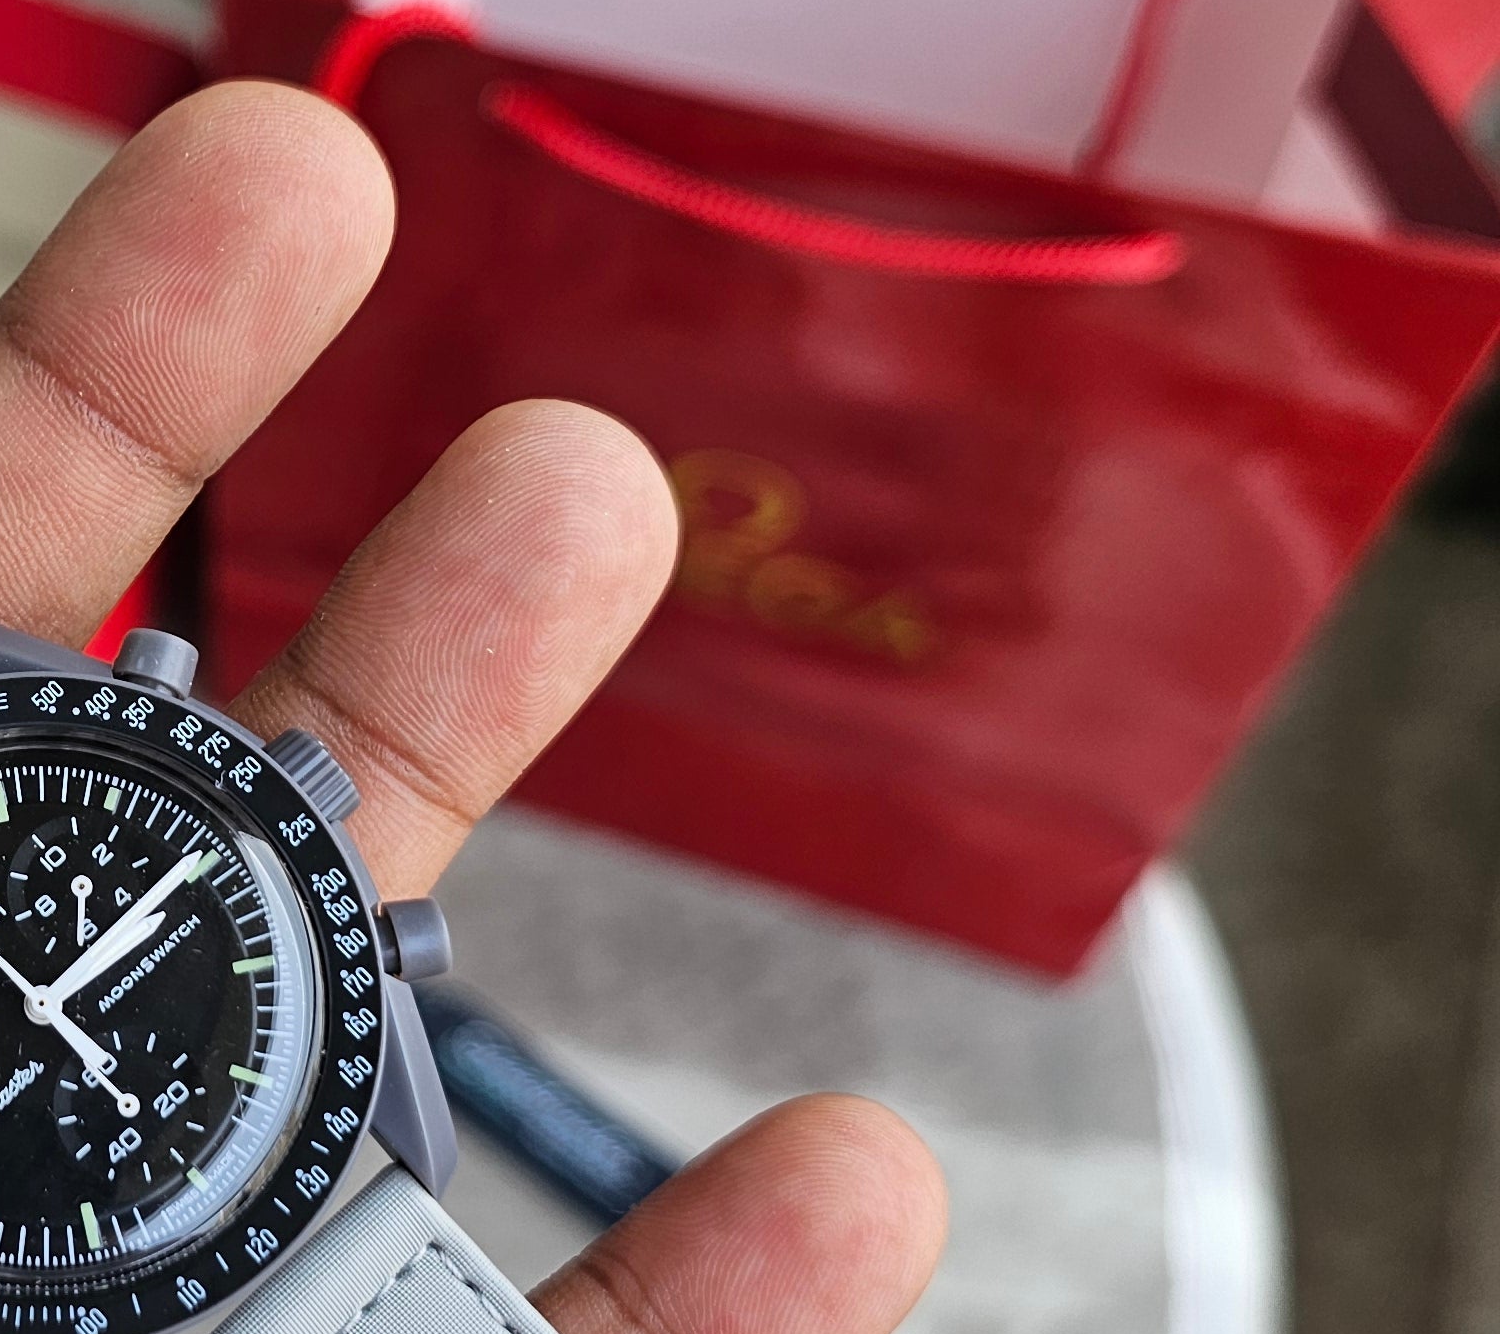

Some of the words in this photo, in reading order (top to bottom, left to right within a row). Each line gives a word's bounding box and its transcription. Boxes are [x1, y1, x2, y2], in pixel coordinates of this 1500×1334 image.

[31, 680, 64, 712] 500
[84, 686, 117, 716] 400
[121, 696, 155, 728] 350
[169, 714, 203, 746] 300
[198, 731, 231, 764] 275
[228, 756, 262, 788] 250
[282, 813, 316, 847] 225
[39, 845, 67, 873] 10
[91, 842, 115, 867] 2
[114, 886, 132, 907] 4
[312, 868, 347, 901] 200
[34, 894, 57, 917] 8
[325, 895, 359, 926] 190
[335, 928, 369, 959] 180
[98, 914, 202, 1014] MOONSWATCH
[342, 967, 374, 998] 170
[345, 1007, 378, 1040] 160
[338, 1054, 373, 1089] 150
[153, 1080, 190, 1118] 20
[326, 1106, 360, 1142] 140
[108, 1127, 142, 1164] 40
[295, 1165, 330, 1200] 130
[245, 1228, 279, 1265] 120
[176, 1278, 206, 1312] 110
